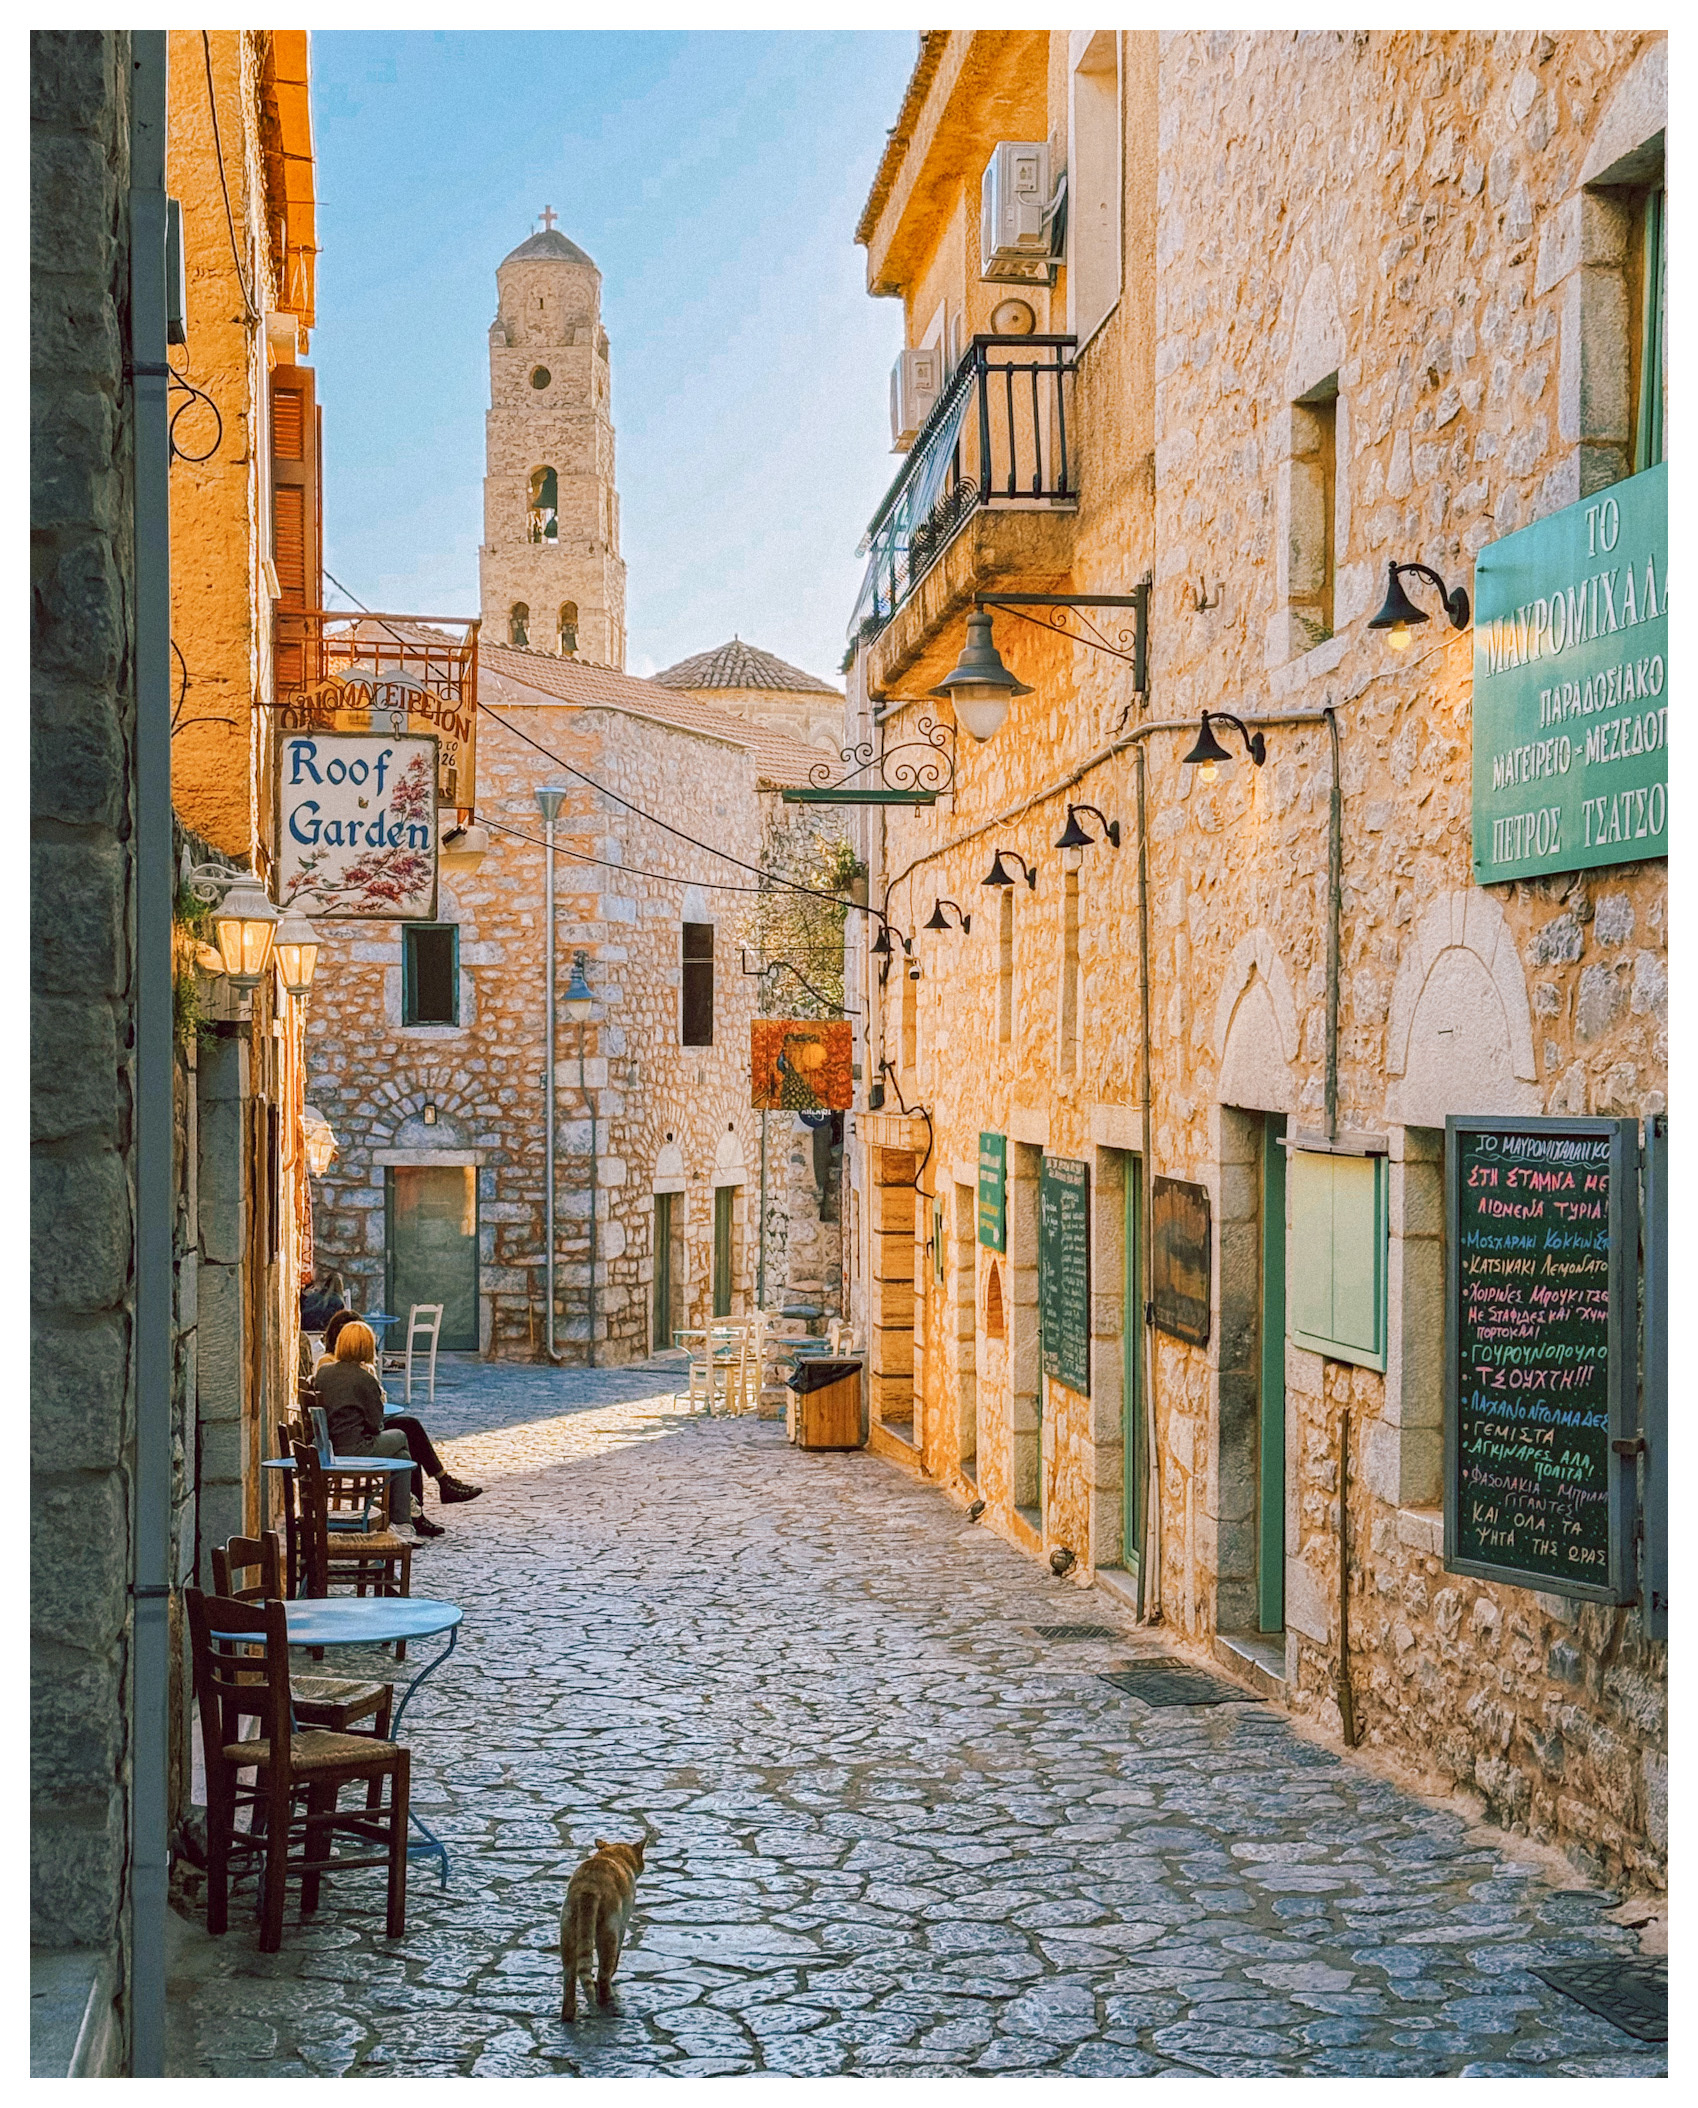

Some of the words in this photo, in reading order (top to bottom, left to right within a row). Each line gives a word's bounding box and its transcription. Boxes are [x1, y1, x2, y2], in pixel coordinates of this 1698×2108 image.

[1585, 498, 1620, 557] ΤΟ
[1540, 654, 1665, 728] ΠΑΡΑΔΟΣΙΑΚΟ
[287, 740, 393, 796] Roof
[1492, 734, 1571, 792] ΜΑΓΕΙΡΕΙΟ
[288, 801, 430, 850] Garden
[1492, 806, 1562, 865] ΠΕΤΡΟΣ
[1582, 782, 1668, 848] ΤΣΑΤΣΟ
[1506, 1166, 1575, 1192] ΣΤΑΜΝΑ
[1576, 1306, 1609, 1325] ΧΥΜ
[1472, 1500, 1499, 1525] ΚΑΙ
[1513, 1512, 1545, 1533] ΟΛΑ
[1562, 1519, 1582, 1536] ΤΑ
[1475, 1526, 1515, 1547] ΨΗΤΑ
[1532, 1537, 1558, 1557] ΤΗΣ
[1568, 1545, 1607, 1567] ΩΡΑΣ
